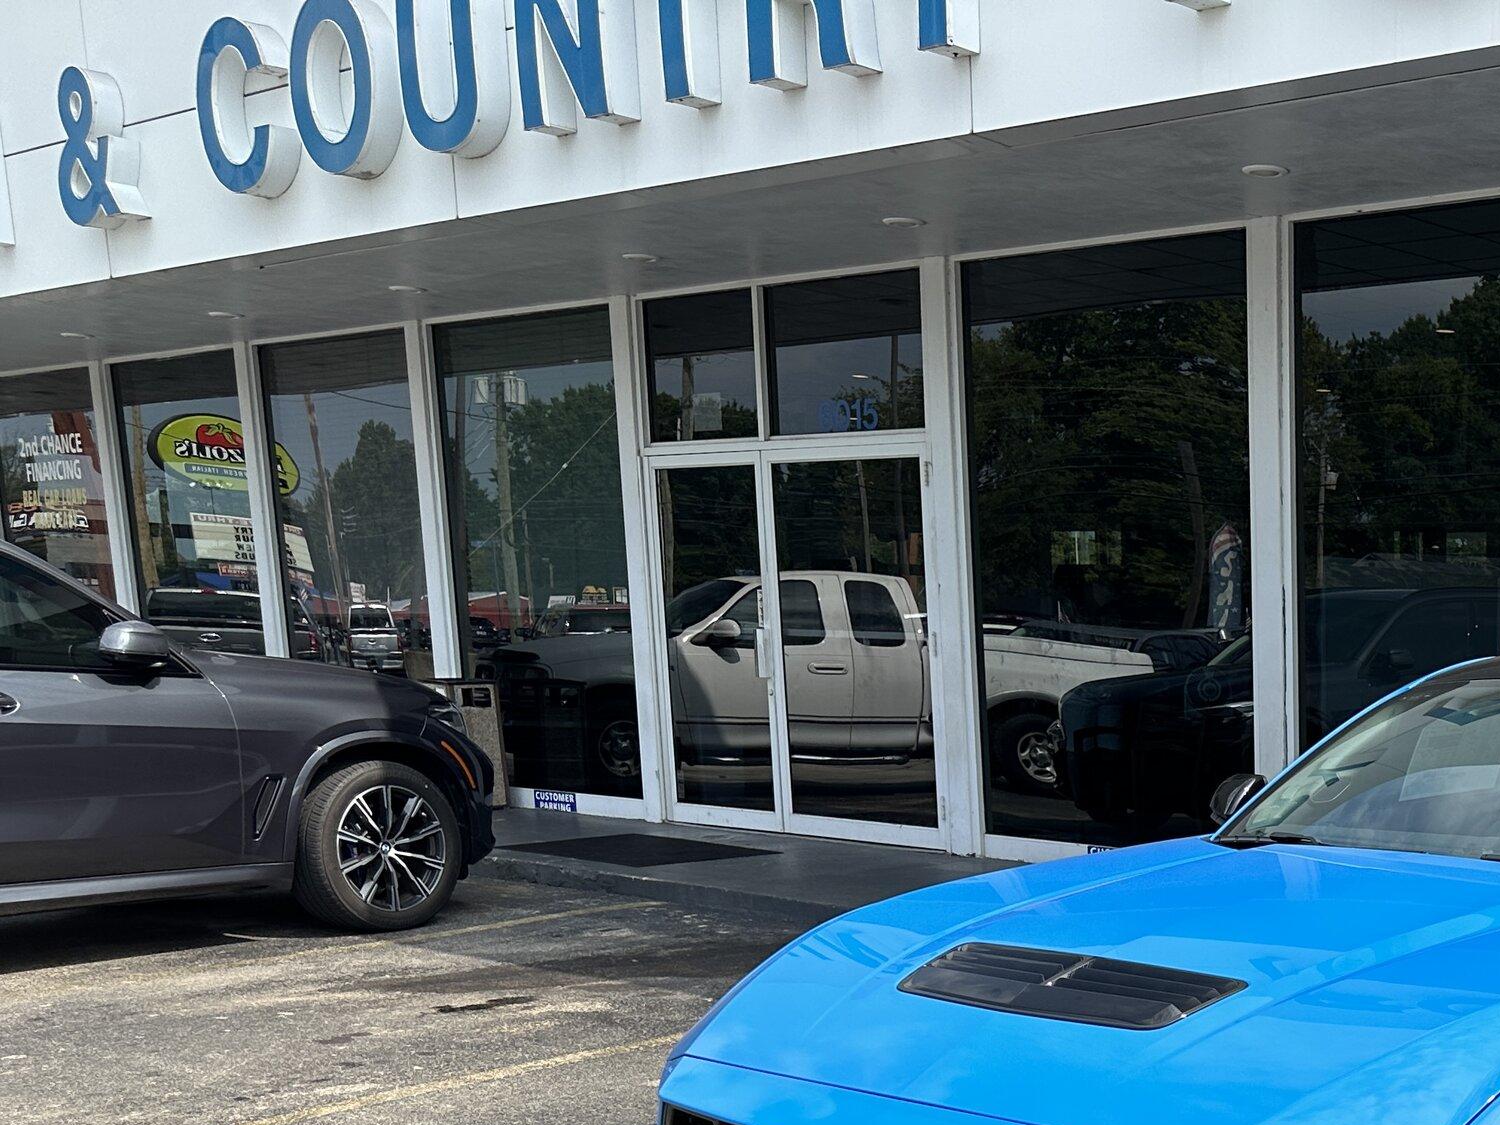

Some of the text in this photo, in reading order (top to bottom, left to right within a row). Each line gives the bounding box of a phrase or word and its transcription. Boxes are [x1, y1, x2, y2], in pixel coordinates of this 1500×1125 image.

[58, 0, 965, 229] & COUN
[19, 432, 83, 457] 2nd CHANCE
[25, 459, 82, 482] FINANCING
[535, 791, 575, 803] CUSTOMER
[539, 801, 571, 812] PARKING
